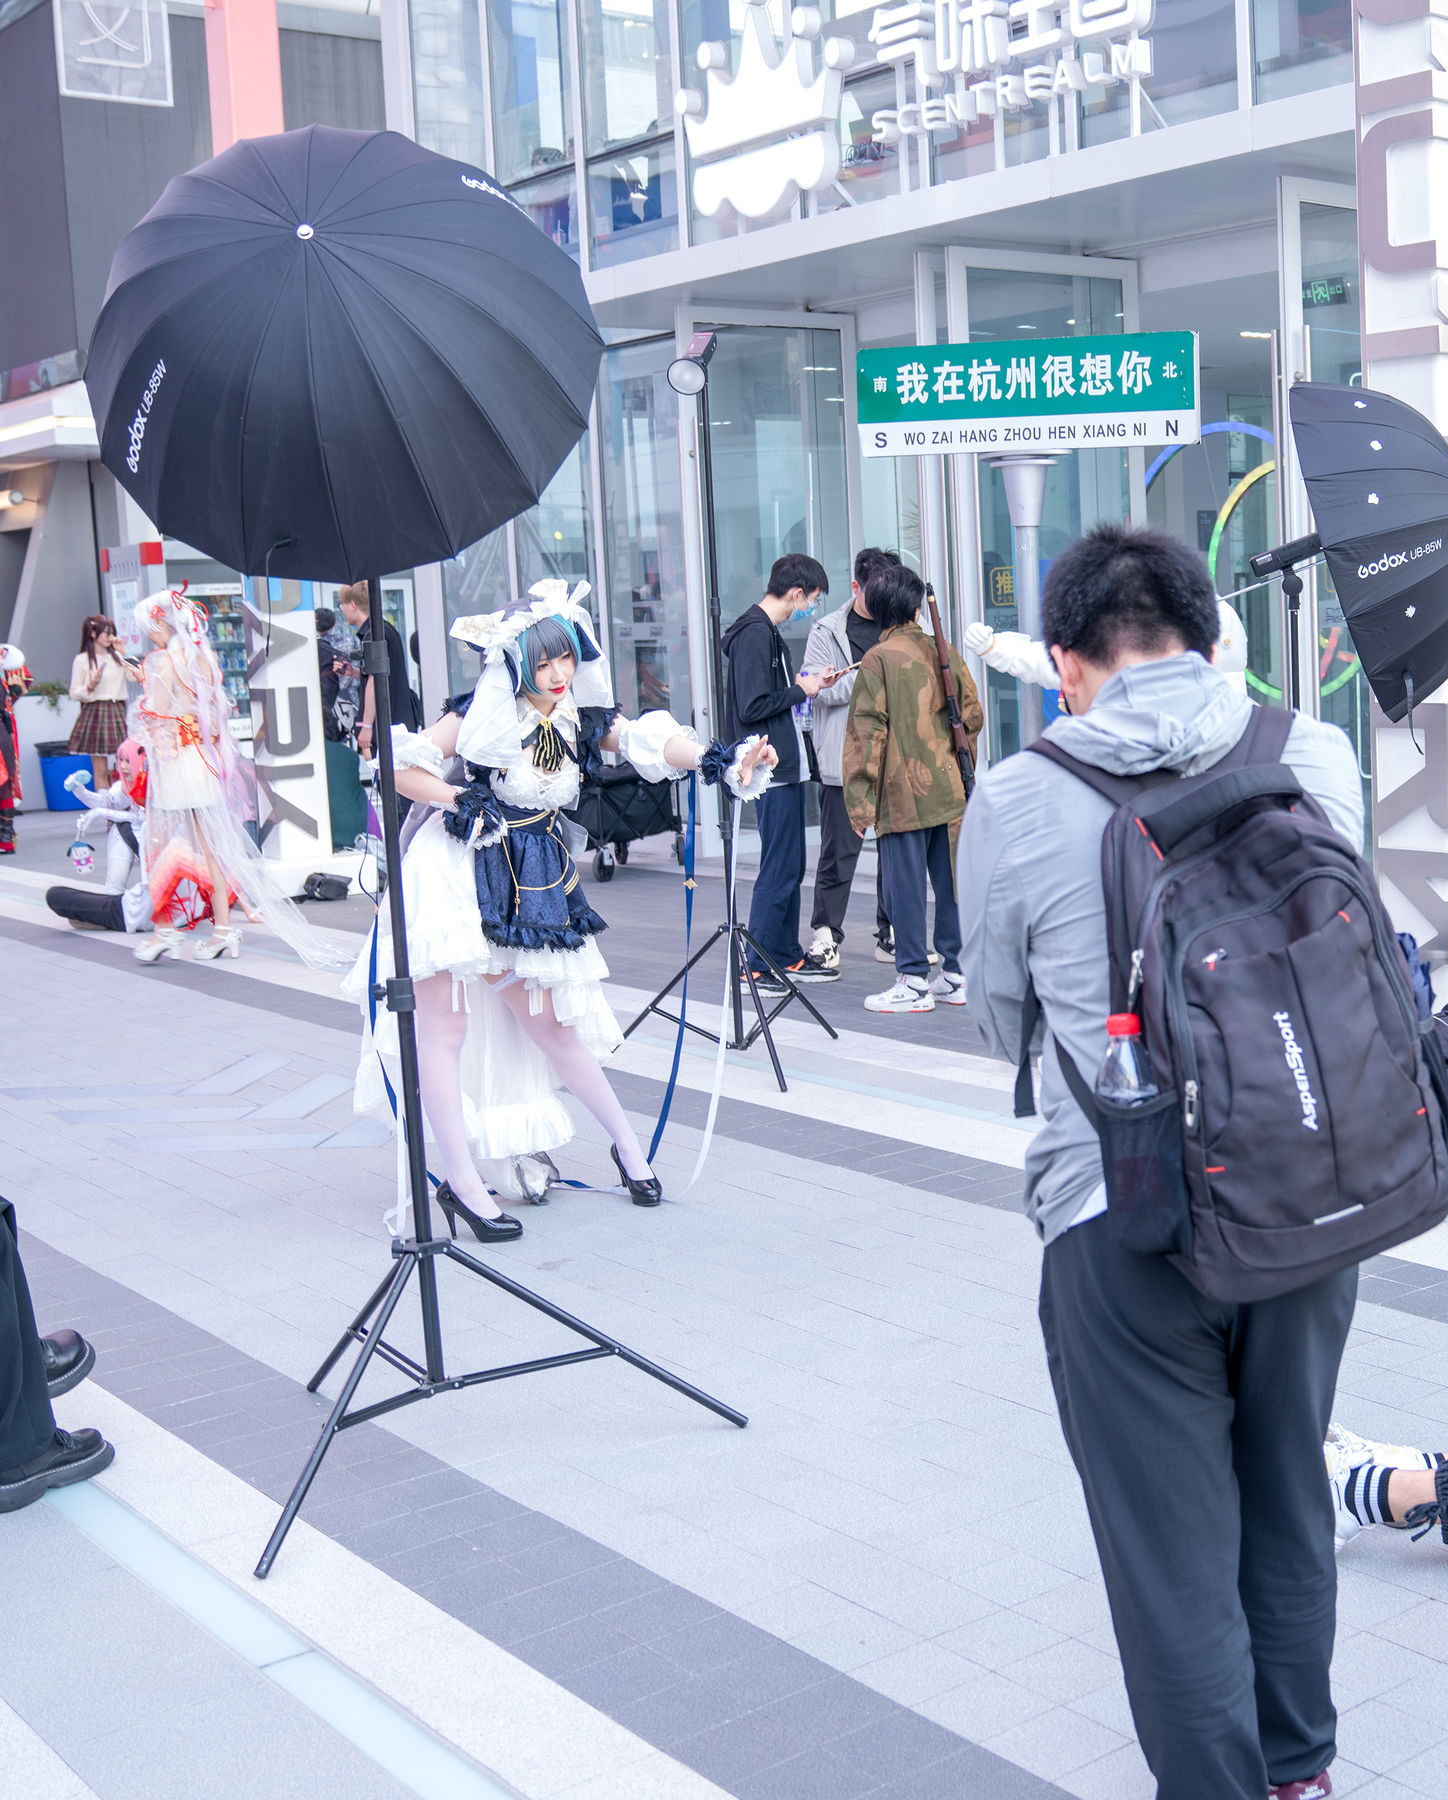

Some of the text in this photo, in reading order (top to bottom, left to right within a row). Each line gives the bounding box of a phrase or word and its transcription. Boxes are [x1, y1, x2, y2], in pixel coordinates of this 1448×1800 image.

[872, 350, 1178, 405] 南 我在杭州很想你 北
[126, 358, 167, 474] Godox UB-85W
[874, 418, 1180, 449] S WO ZAI HANG ZHOU HEN XIANG NI N
[995, 570, 1014, 595] 推
[1357, 538, 1443, 579] Godox UB-85W
[1272, 1011, 1319, 1132] AspenSport
